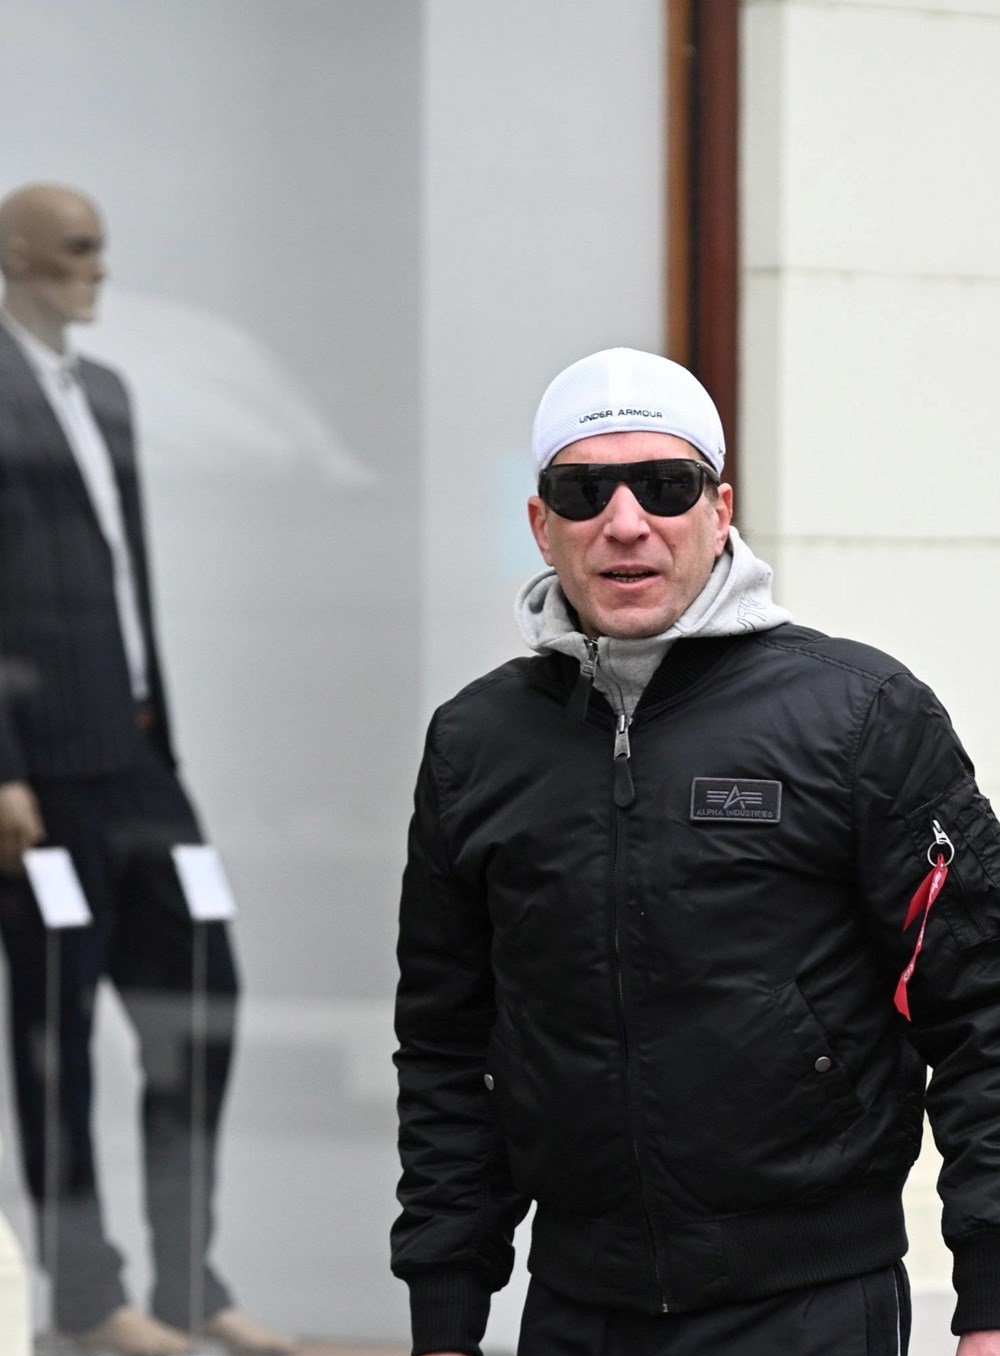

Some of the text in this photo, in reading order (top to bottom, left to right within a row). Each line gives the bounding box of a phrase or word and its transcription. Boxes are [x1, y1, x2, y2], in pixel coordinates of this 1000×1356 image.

[579, 408, 662, 423] UNDER ARMOUR
[696, 808, 774, 818] ALPHA INDUSTRIES
